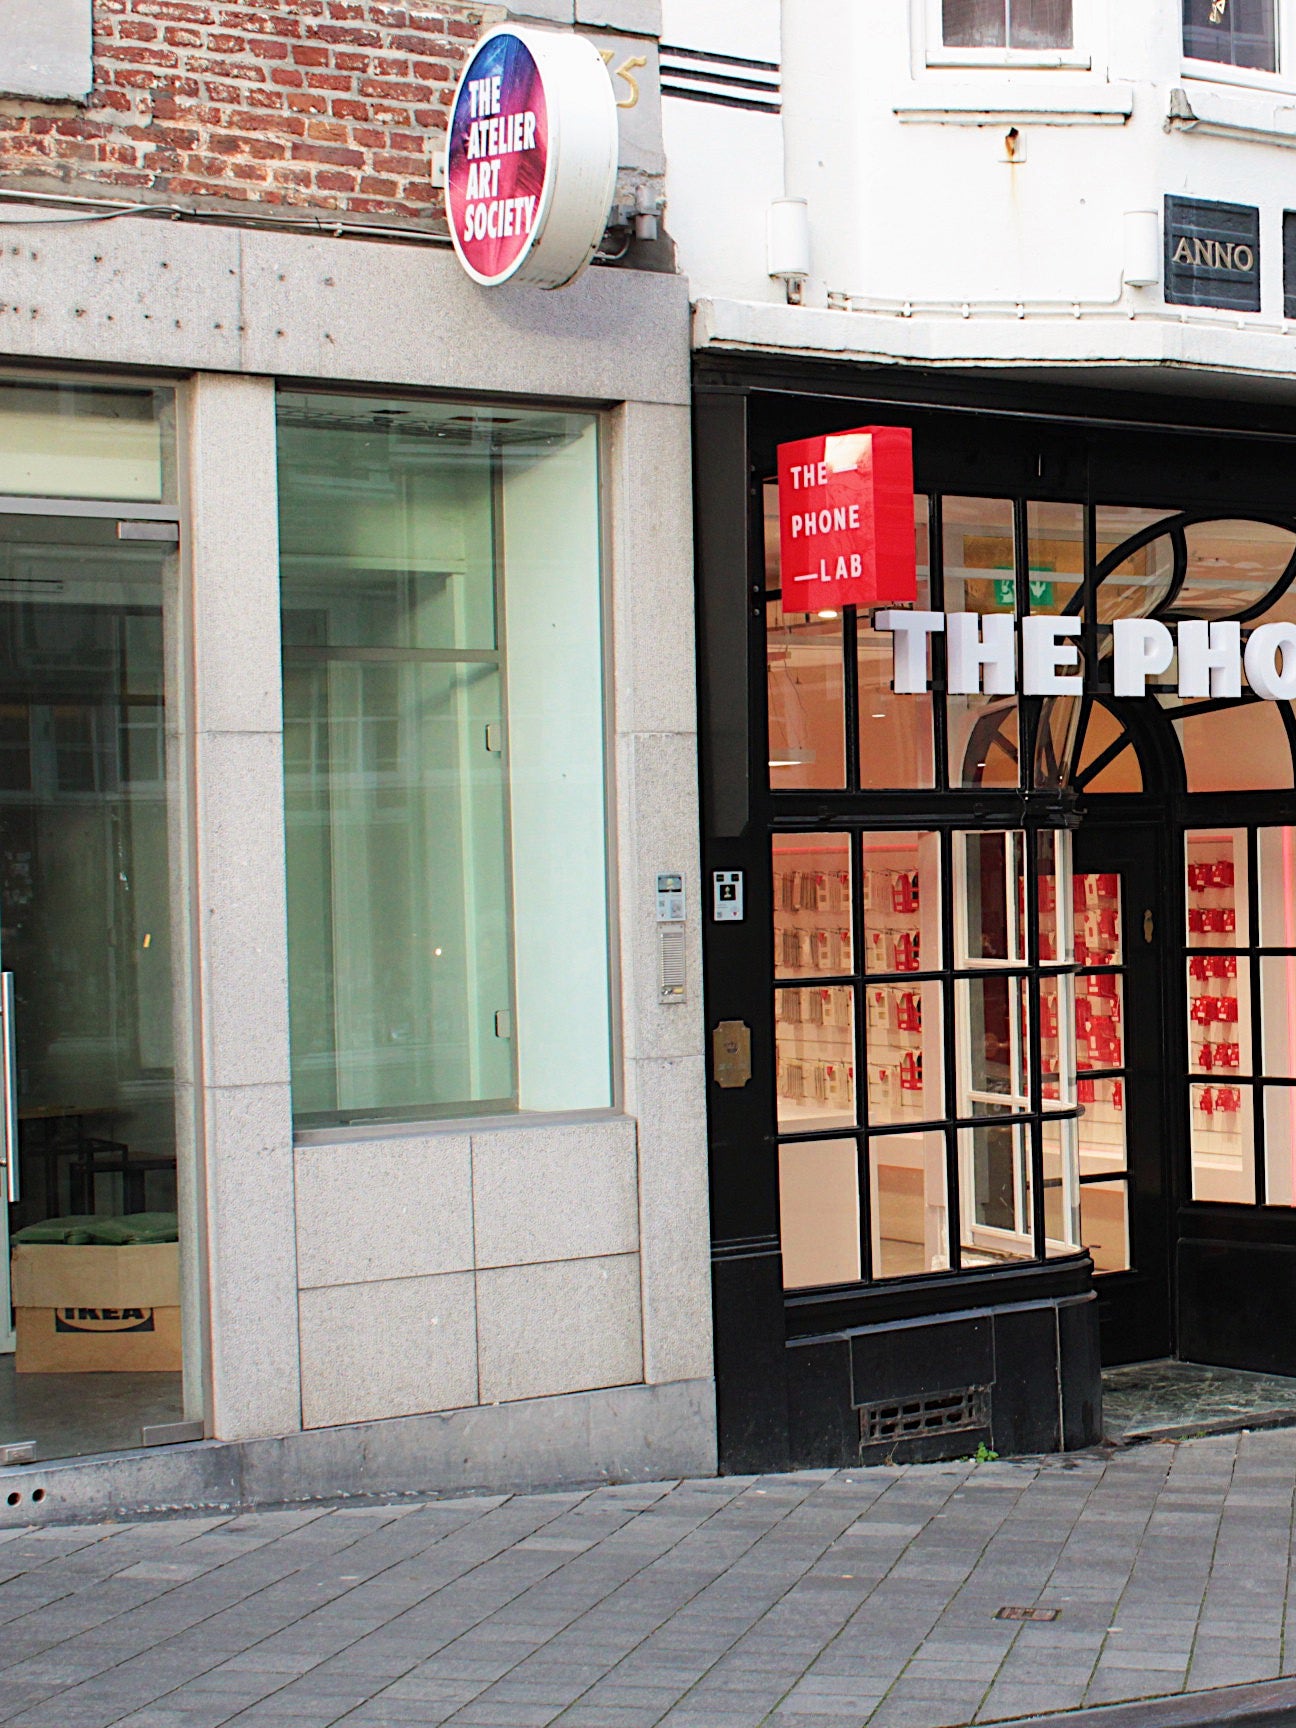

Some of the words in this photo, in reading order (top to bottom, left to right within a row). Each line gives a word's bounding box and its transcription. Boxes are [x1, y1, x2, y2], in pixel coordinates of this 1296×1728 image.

[468, 76, 501, 118] THE
[599, 48, 647, 109] 5
[467, 111, 536, 160] ATELIER
[466, 159, 500, 200] ART
[463, 195, 536, 242] SOCIETY
[1172, 236, 1255, 272] ANNO
[791, 461, 828, 490] THE
[791, 504, 860, 538] PHONE
[875, 609, 1084, 695] THE
[63, 1307, 145, 1321] IKEA
